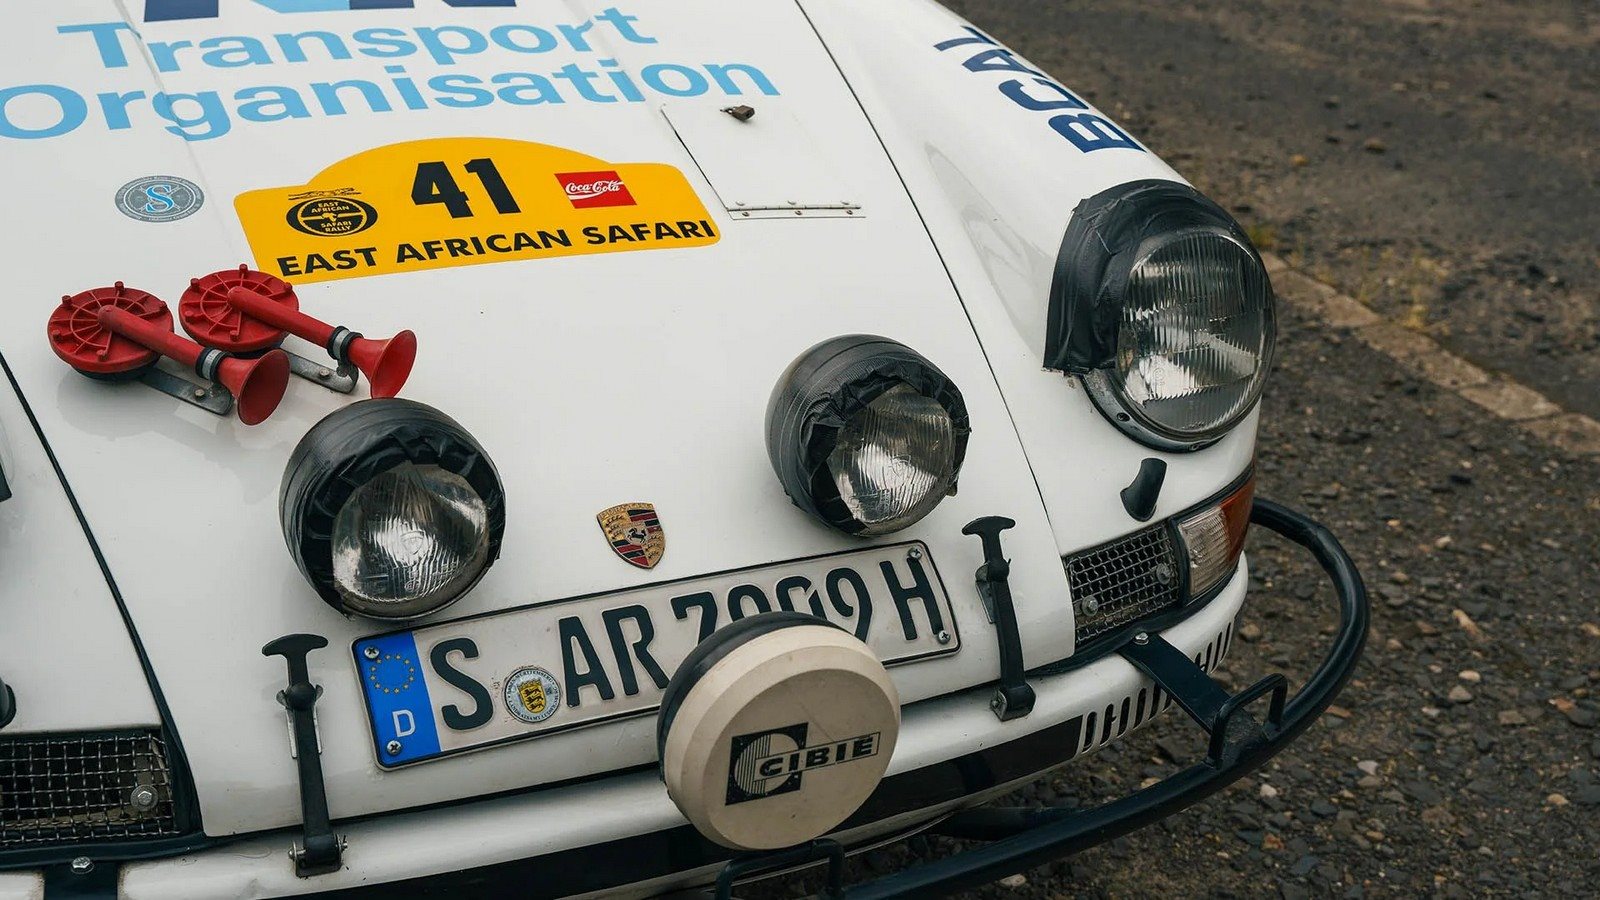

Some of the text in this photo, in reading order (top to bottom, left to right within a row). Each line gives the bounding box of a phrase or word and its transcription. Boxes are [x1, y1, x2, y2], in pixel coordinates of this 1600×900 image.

[56, 7, 658, 73] Transport
[0, 58, 780, 142] Organisation
[933, 25, 1148, 153] BCAL
[145, 184, 175, 213] S
[311, 205, 350, 213] AFRICAN
[411, 158, 521, 219] 41
[565, 180, 620, 195] Coca-Cola
[276, 220, 716, 277] EAST AFRICAN SAFARI
[320, 220, 352, 228] SAFARI
[430, 637, 494, 731] S
[558, 604, 670, 708] AR
[391, 709, 416, 738] D
